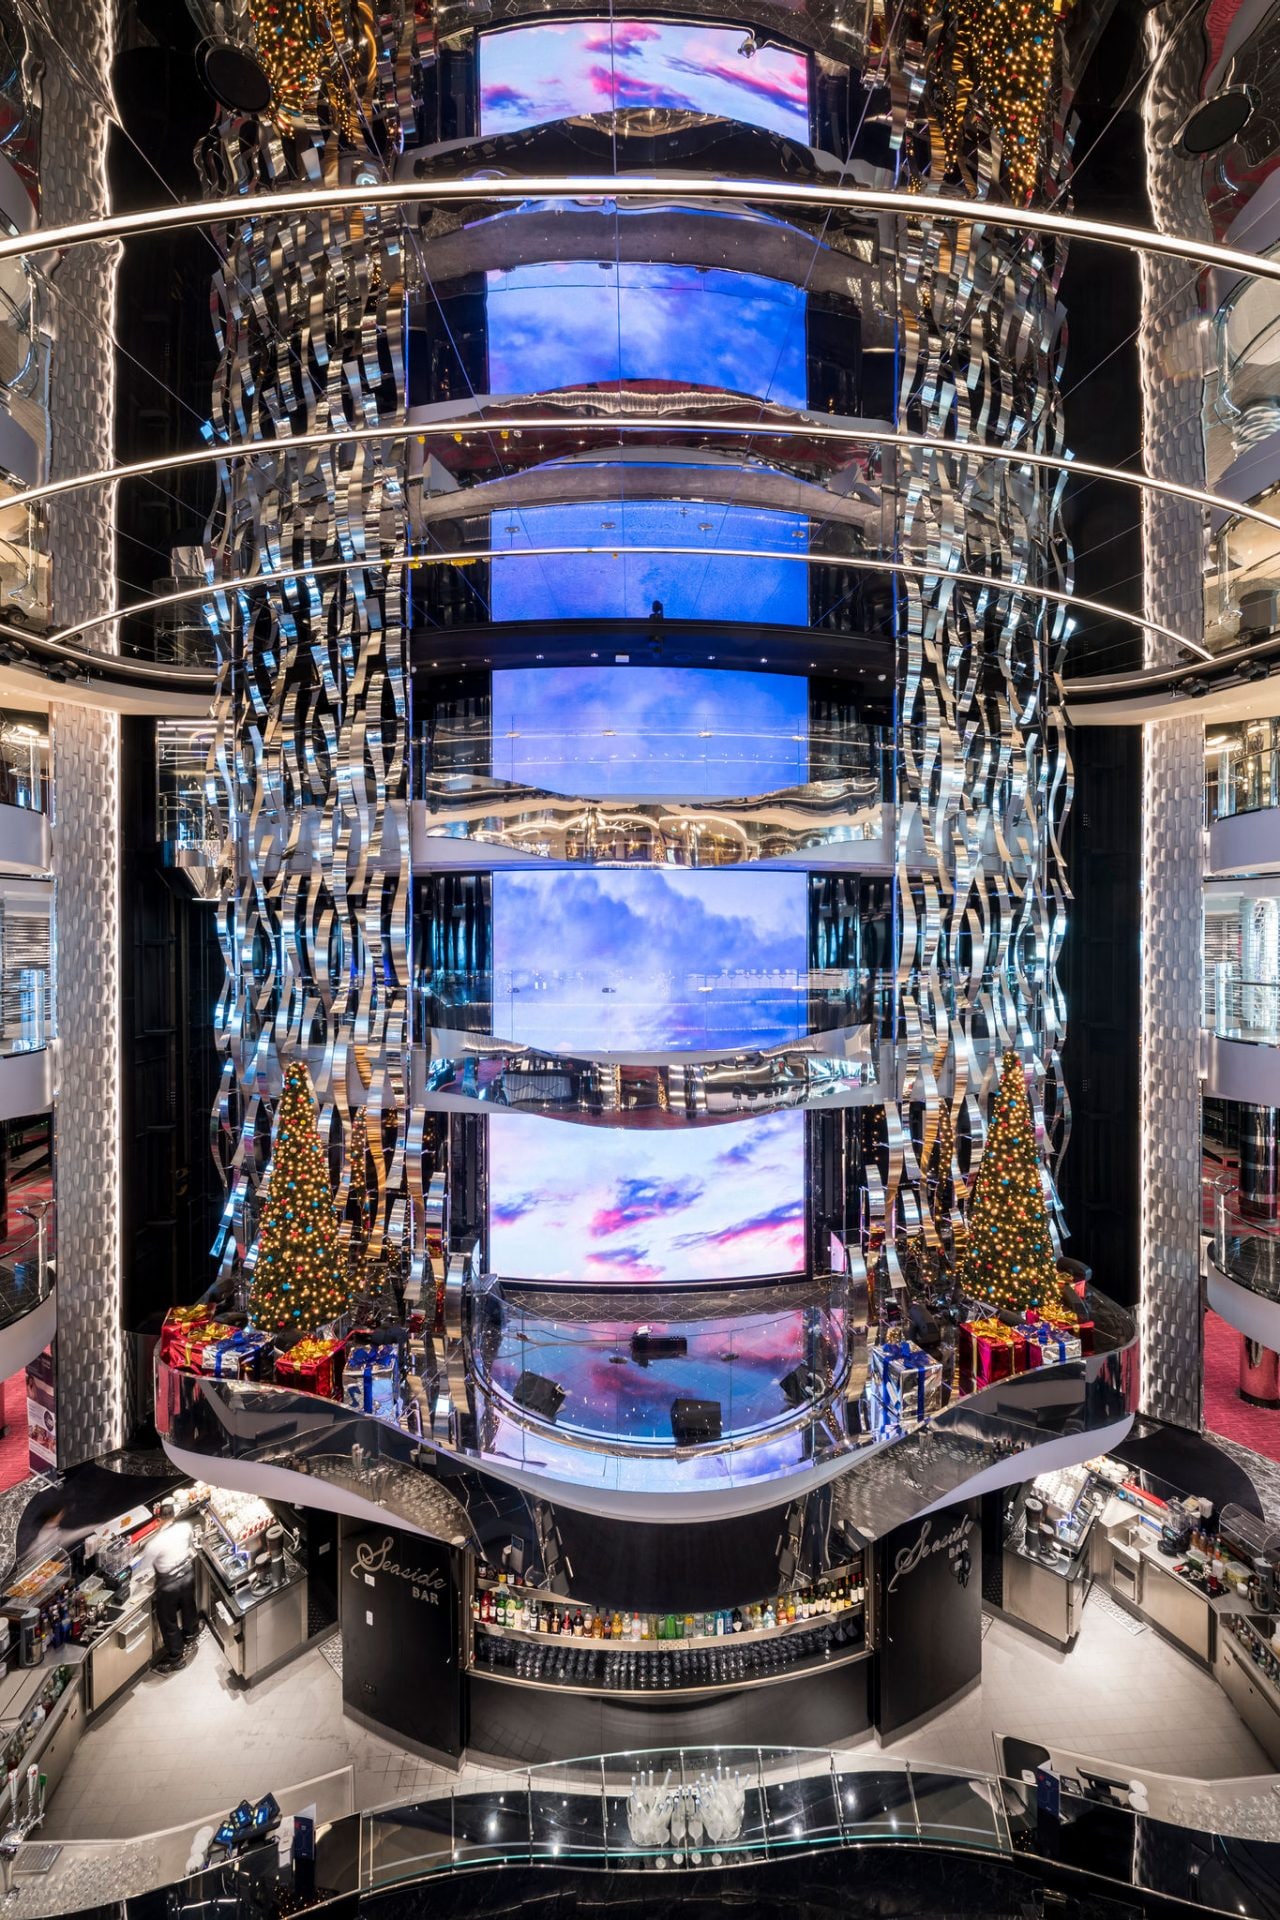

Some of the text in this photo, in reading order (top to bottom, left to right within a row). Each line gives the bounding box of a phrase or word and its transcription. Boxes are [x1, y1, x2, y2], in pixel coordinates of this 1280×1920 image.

[350, 1536, 447, 1589] Seaside
[887, 1513, 975, 1593] Seaside
[949, 1539, 968, 1559] BAR
[411, 1585, 439, 1605] BAR
